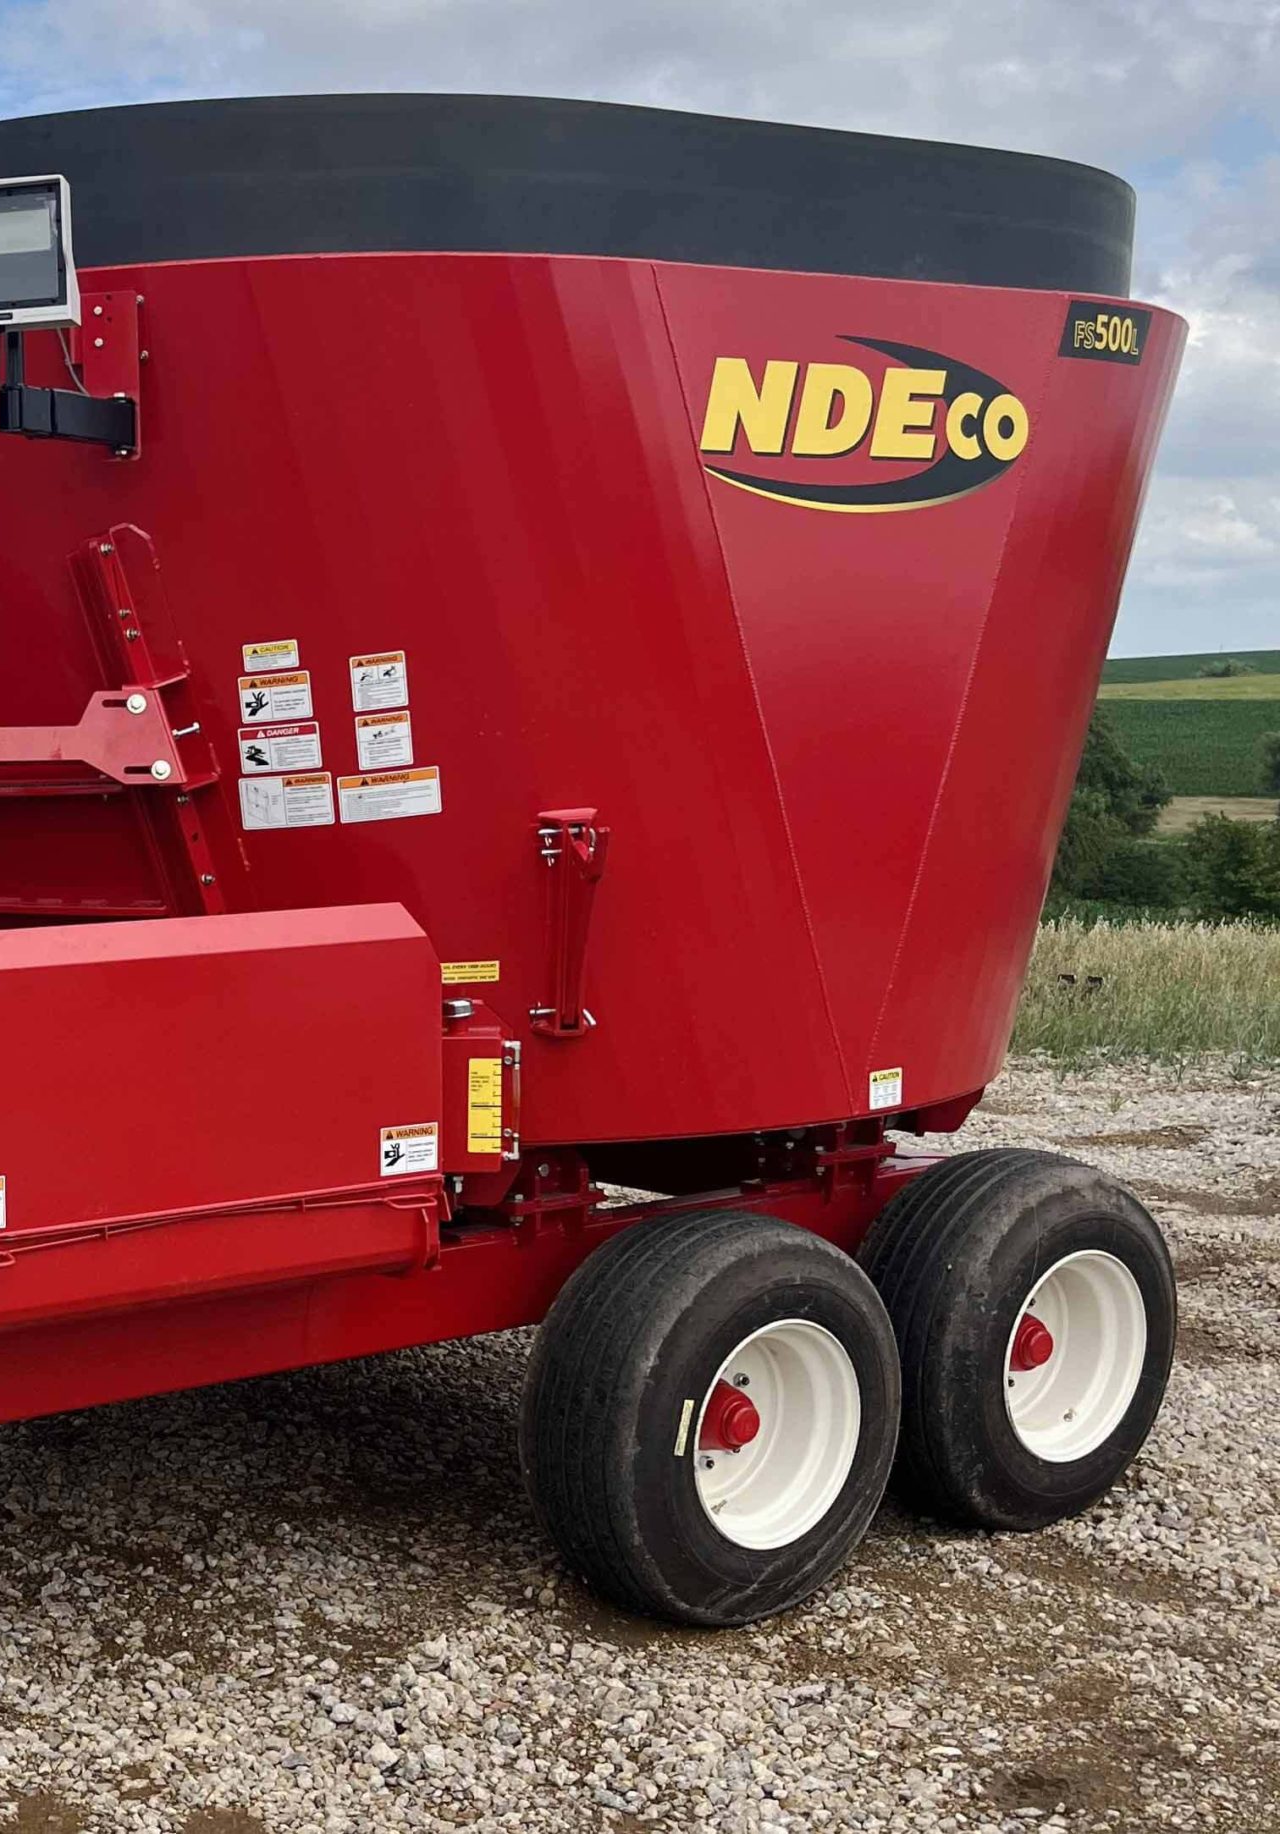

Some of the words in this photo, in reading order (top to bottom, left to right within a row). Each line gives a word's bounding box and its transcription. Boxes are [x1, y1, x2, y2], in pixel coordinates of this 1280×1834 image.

[259, 644, 289, 653] CAUTION
[260, 675, 299, 686] WARNING
[370, 715, 404, 724] WARNING
[266, 727, 300, 737] DANGER
[370, 773, 410, 783] WARNING
[395, 1126, 433, 1138] WARNING
